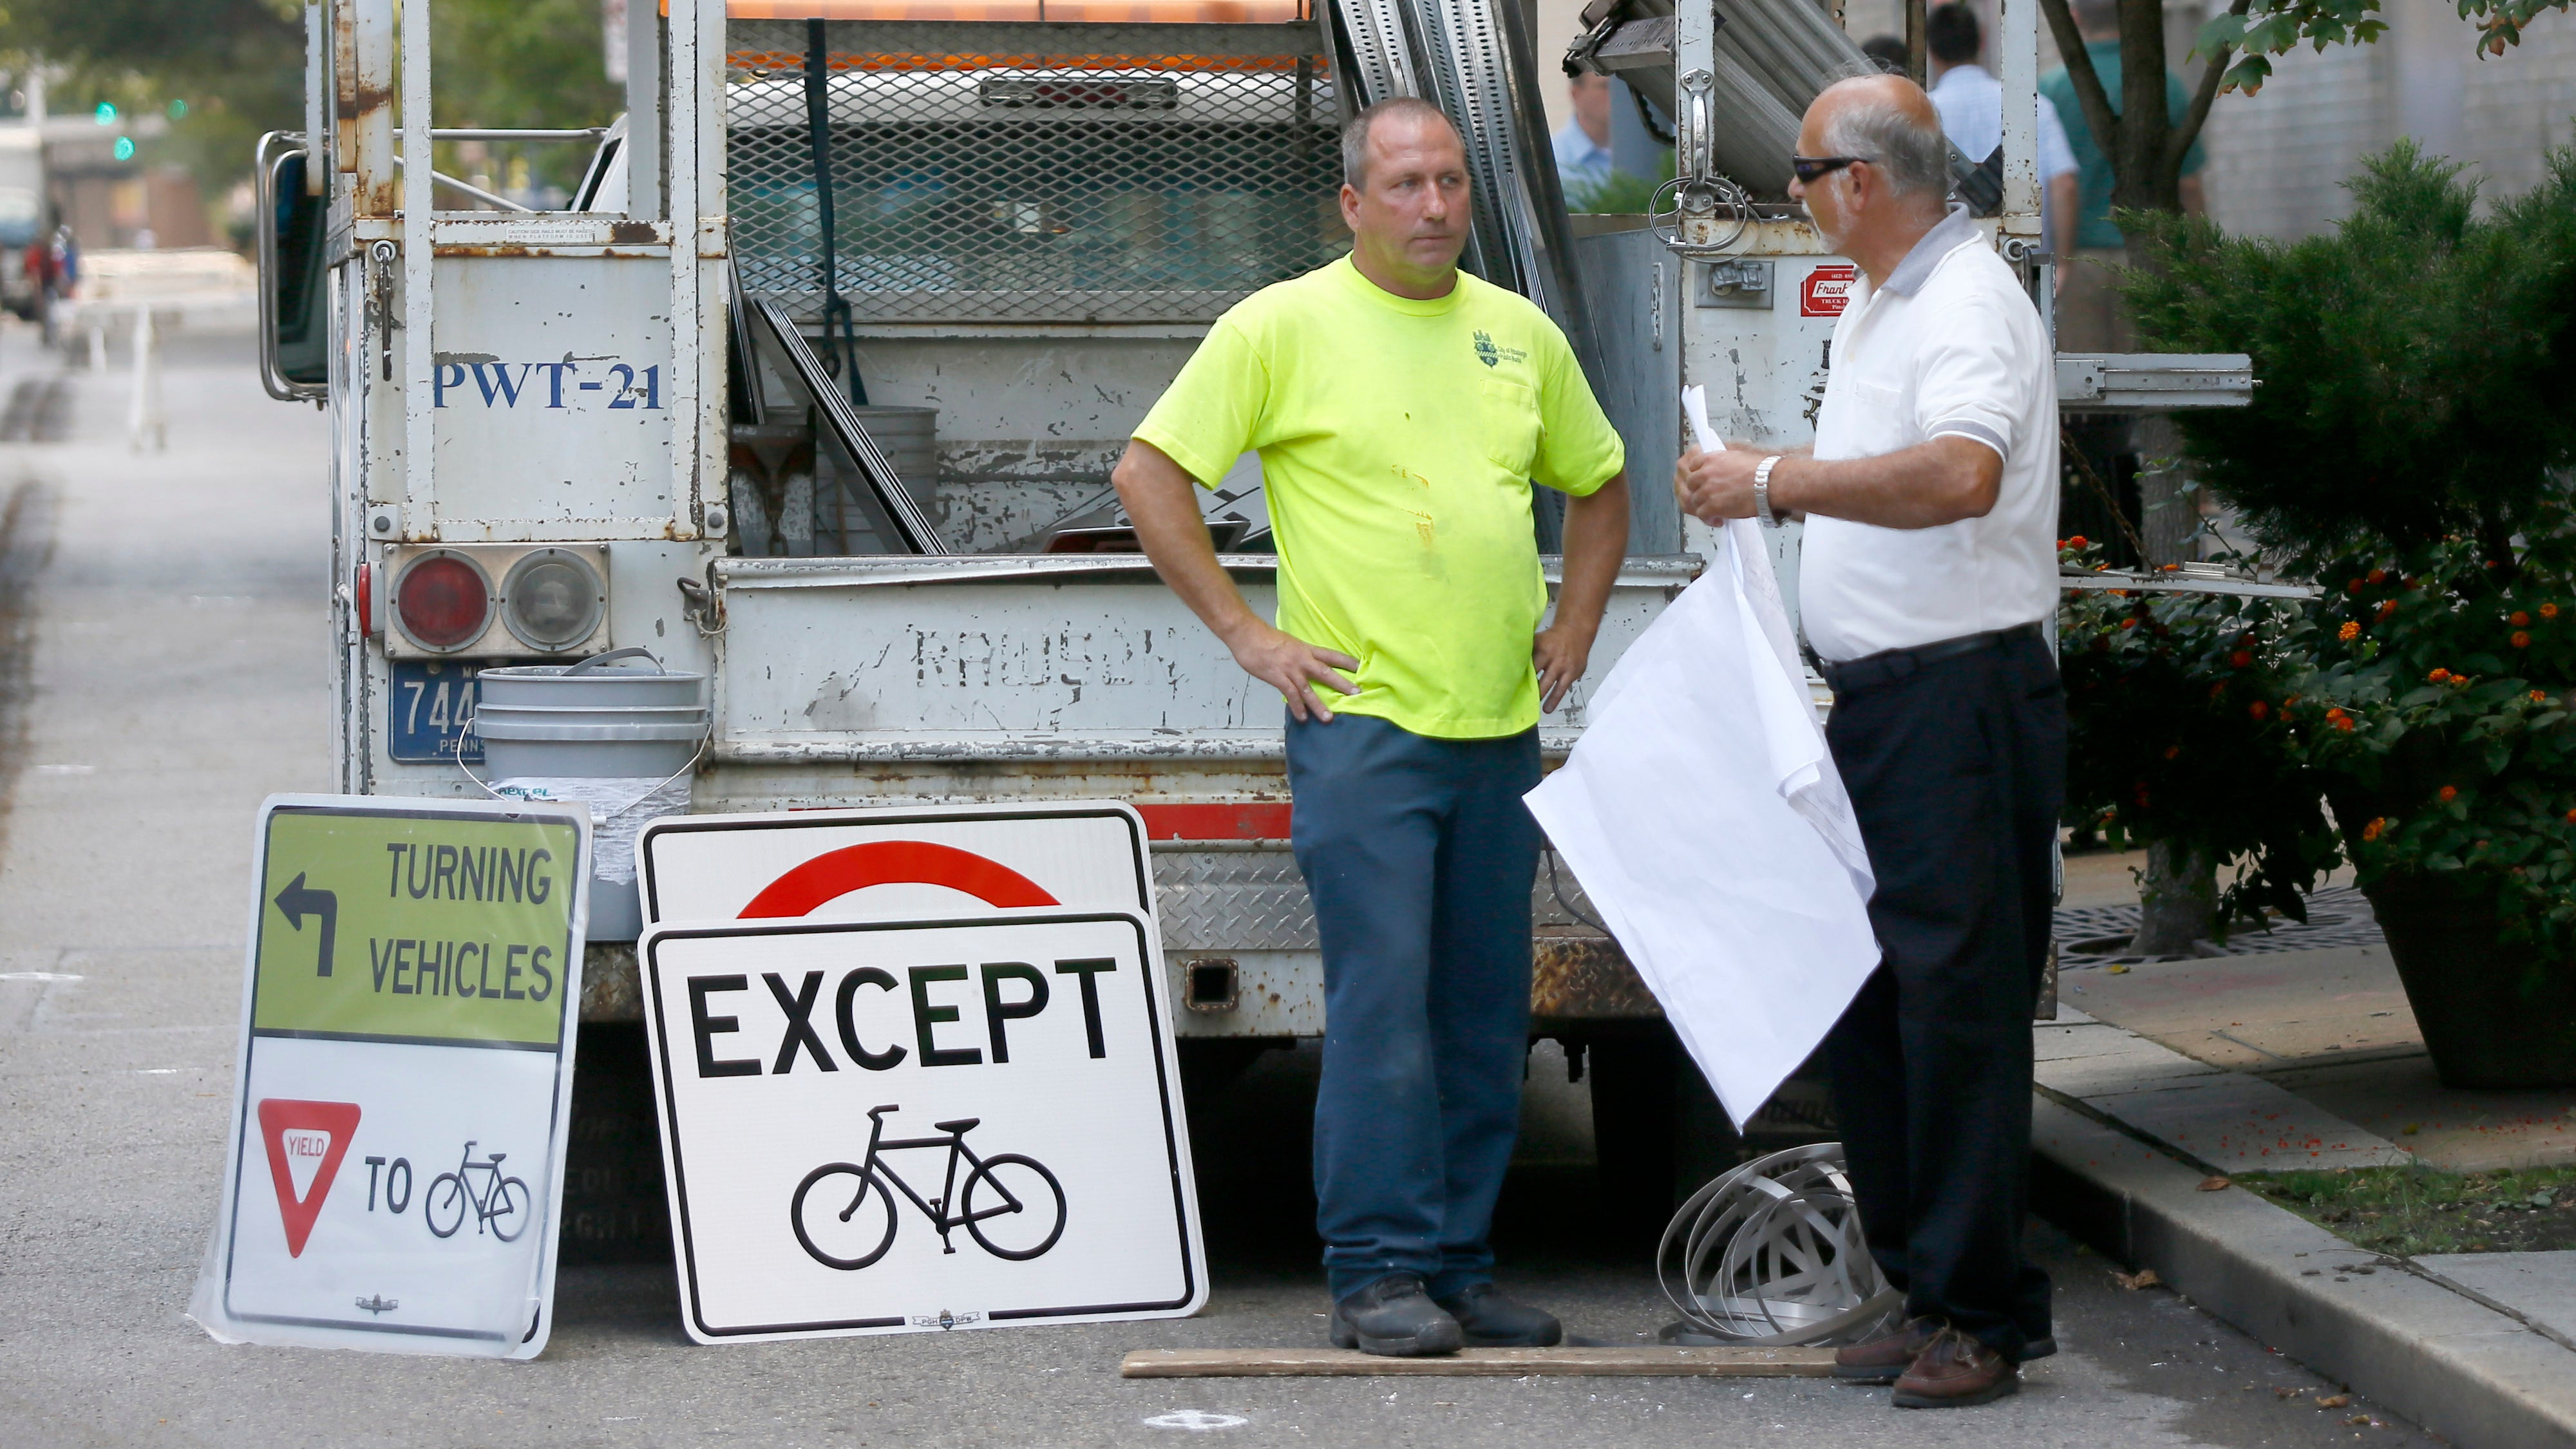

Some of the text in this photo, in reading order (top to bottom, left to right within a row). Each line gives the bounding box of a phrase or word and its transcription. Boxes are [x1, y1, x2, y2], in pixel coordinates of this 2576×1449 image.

[434, 363, 664, 409] PWT-21
[387, 842, 552, 905] TURNING
[370, 938, 553, 1002] VEHICLES
[687, 957, 1117, 1078] EXCEPT
[289, 1136, 325, 1157] YIELD
[365, 1156, 412, 1214] TO
